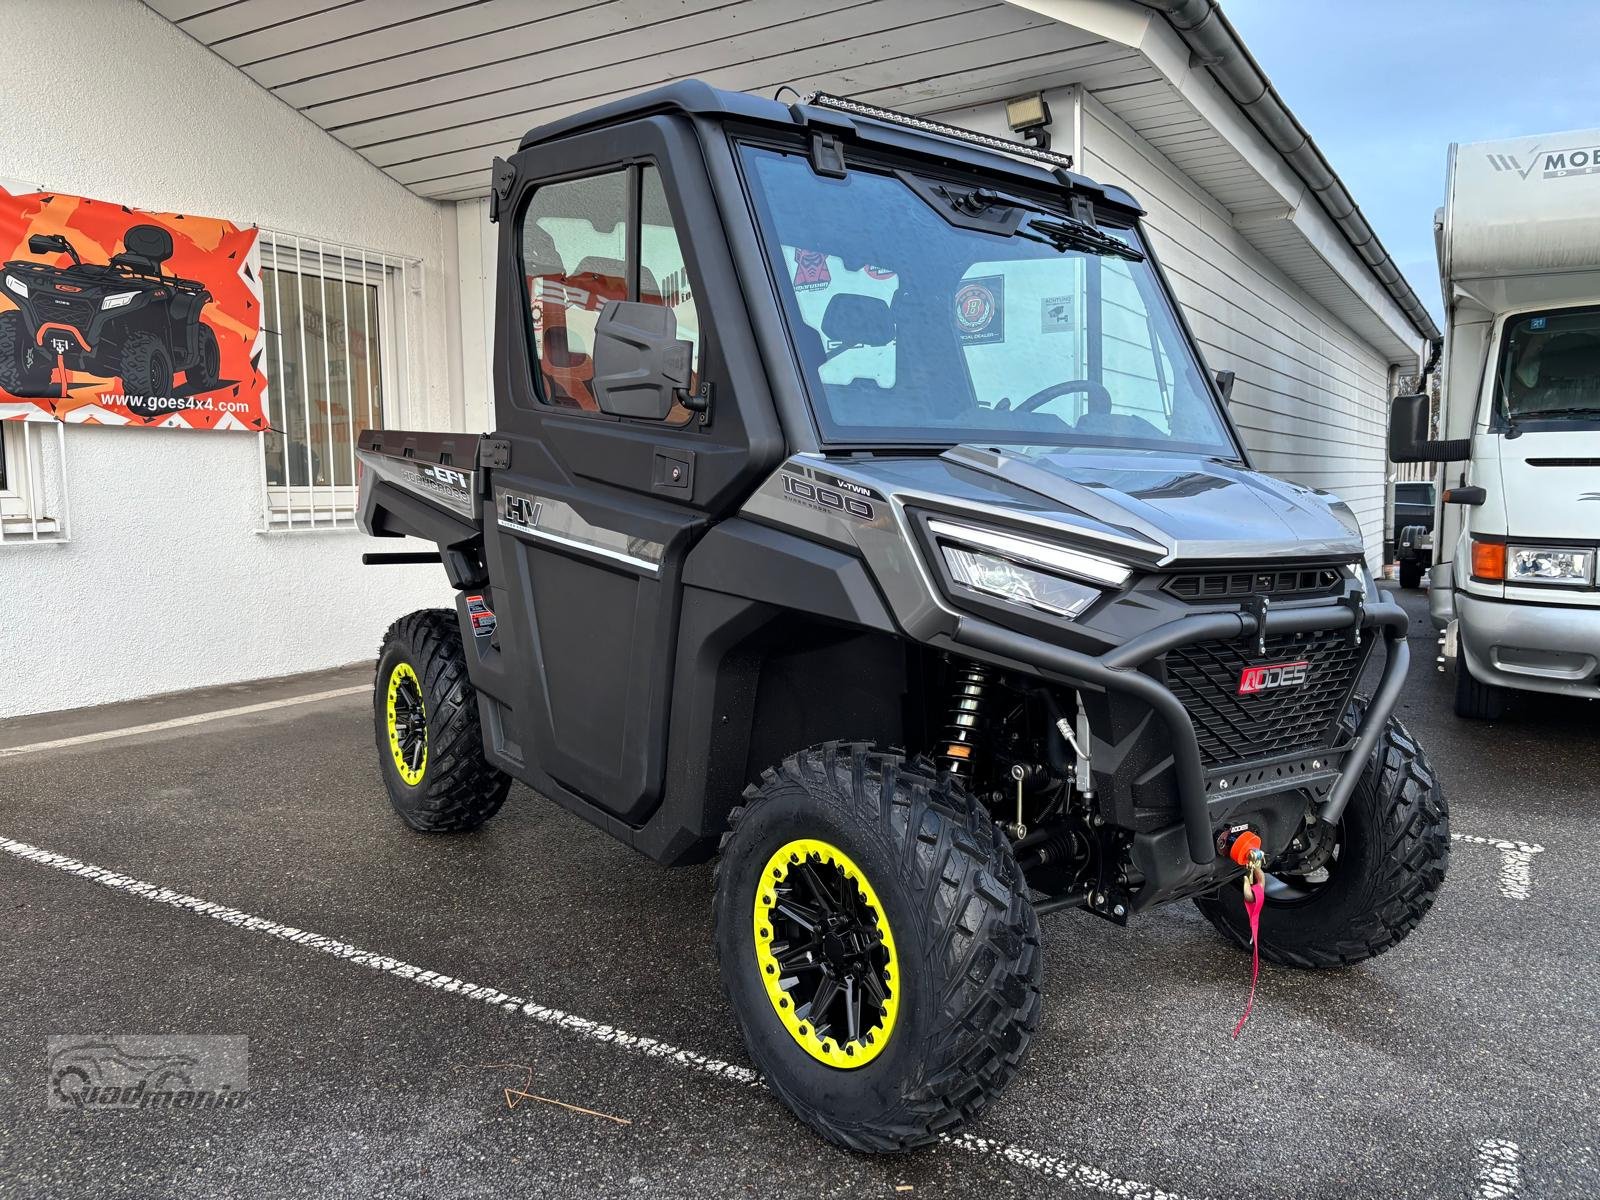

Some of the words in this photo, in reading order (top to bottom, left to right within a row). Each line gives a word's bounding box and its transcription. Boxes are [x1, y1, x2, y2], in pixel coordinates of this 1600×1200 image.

[100, 393, 249, 413] www.goes4x4.com
[433, 466, 468, 489] EFI
[836, 479, 871, 497] V-TWIN
[780, 473, 875, 521] 1000
[505, 494, 543, 527] HV
